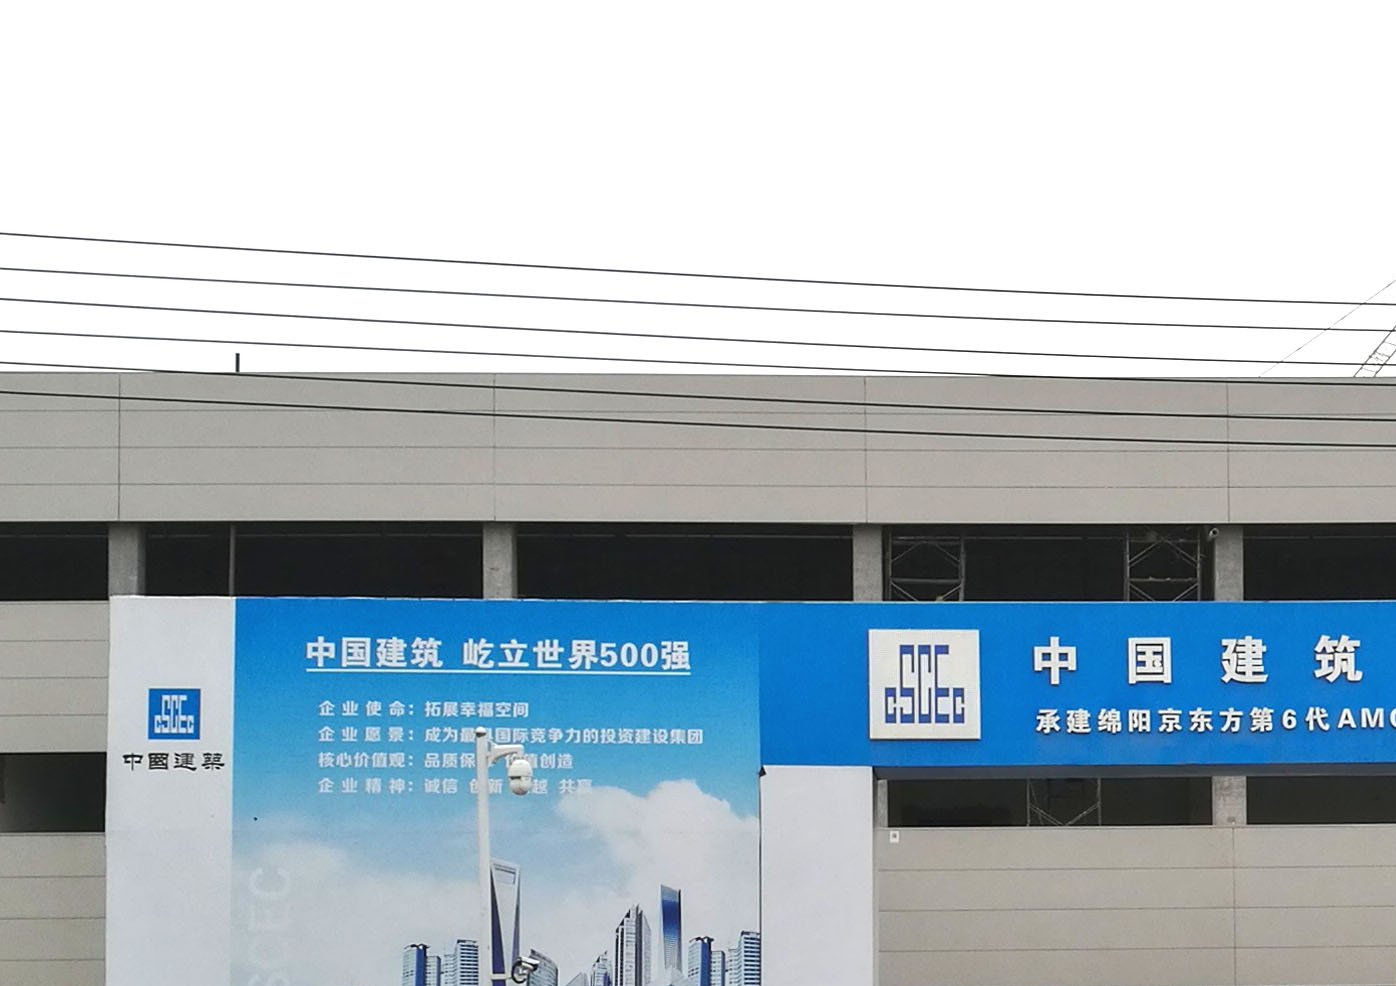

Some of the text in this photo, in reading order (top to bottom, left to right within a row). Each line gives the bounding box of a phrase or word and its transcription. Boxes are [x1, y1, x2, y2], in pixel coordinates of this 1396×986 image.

[306, 638, 691, 668] 中国建筑 屹立世界500强
[424, 701, 529, 718] 拓展幸福空间
[318, 752, 415, 768] 核心价值观：
